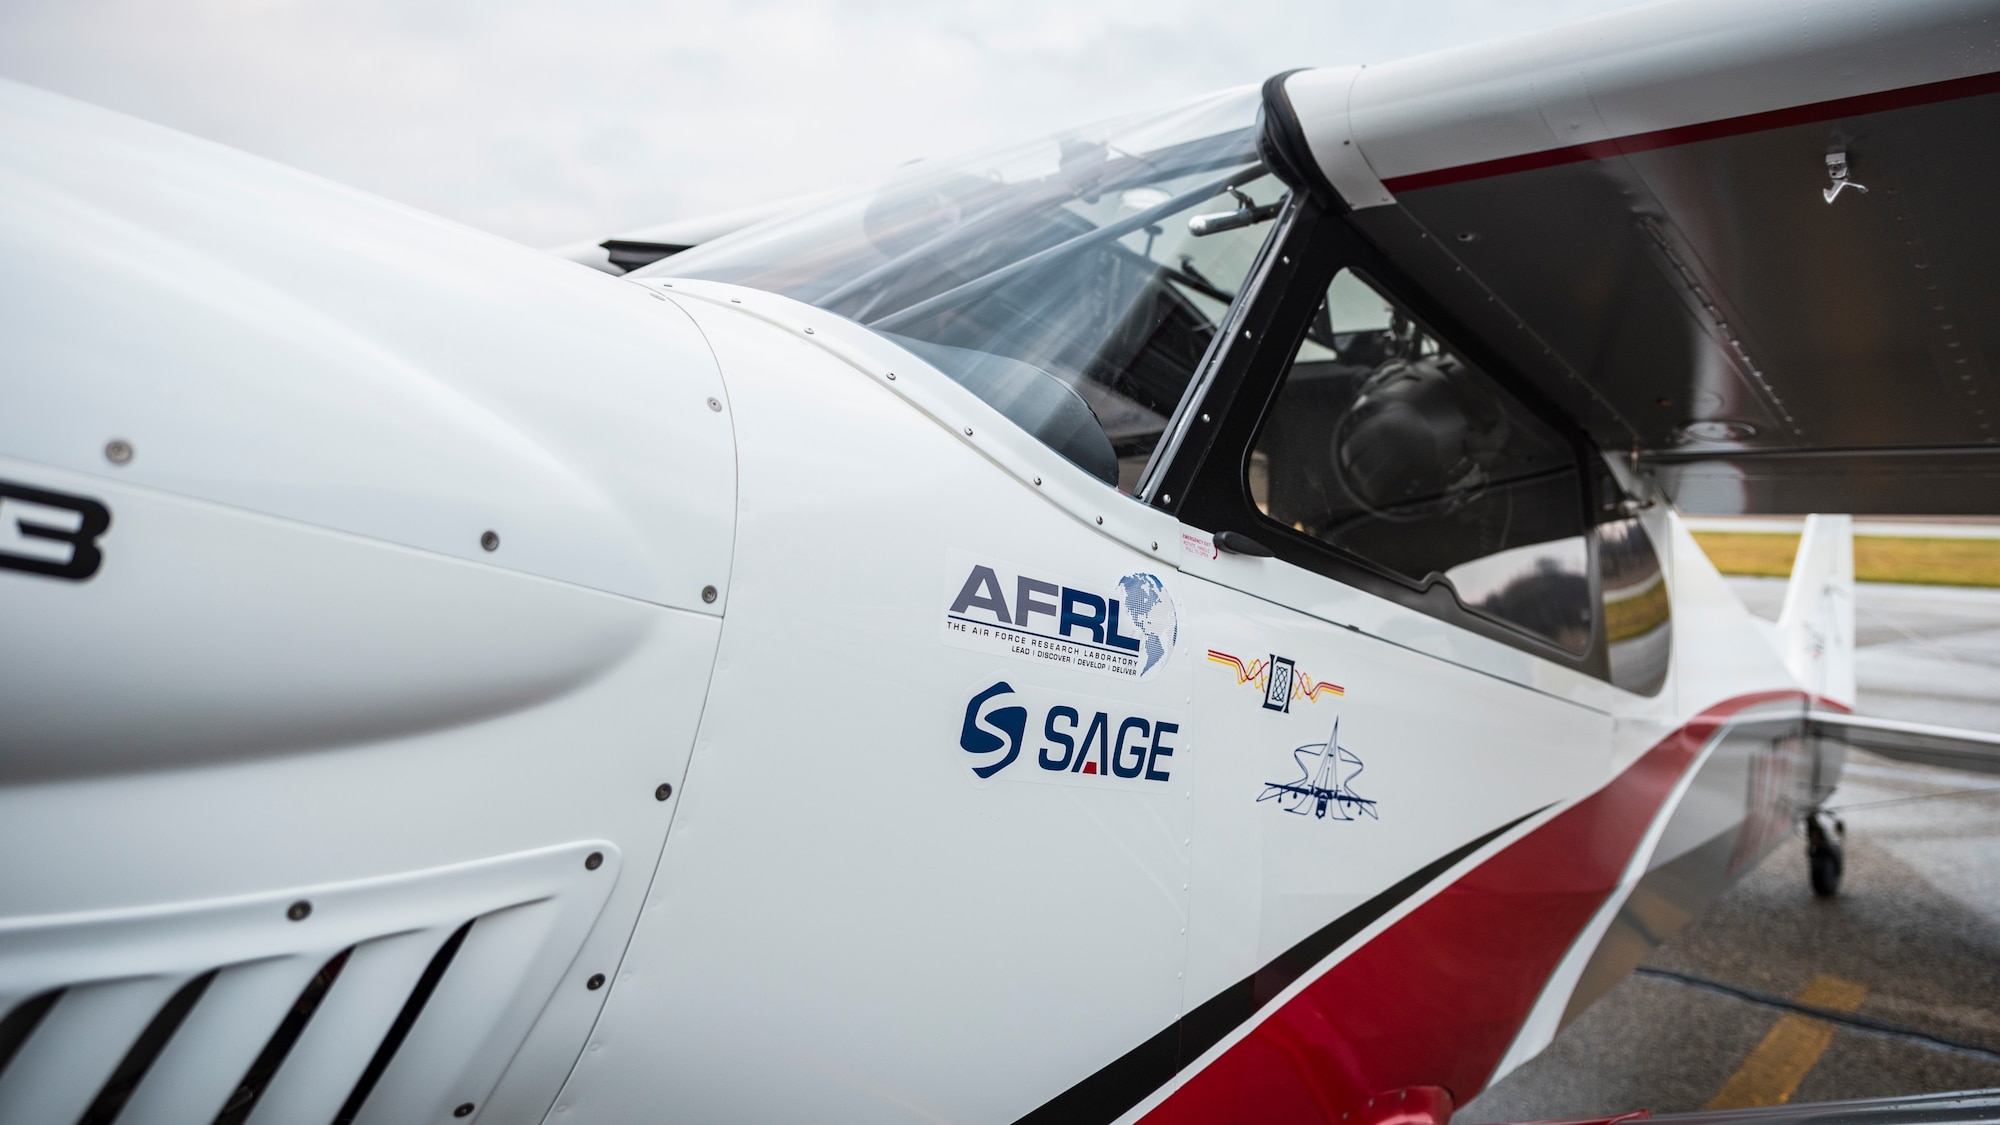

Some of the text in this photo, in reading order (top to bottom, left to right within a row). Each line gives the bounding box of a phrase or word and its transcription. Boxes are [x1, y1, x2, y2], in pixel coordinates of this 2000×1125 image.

[949, 564, 1141, 652] AFRL
[947, 621, 1139, 667] THE AIR FORCE RESEARCH LABORATORY
[1011, 645, 1137, 676] LEAD DISCOVER DEVELOP DELIVER
[1038, 705, 1180, 782] SAGE
